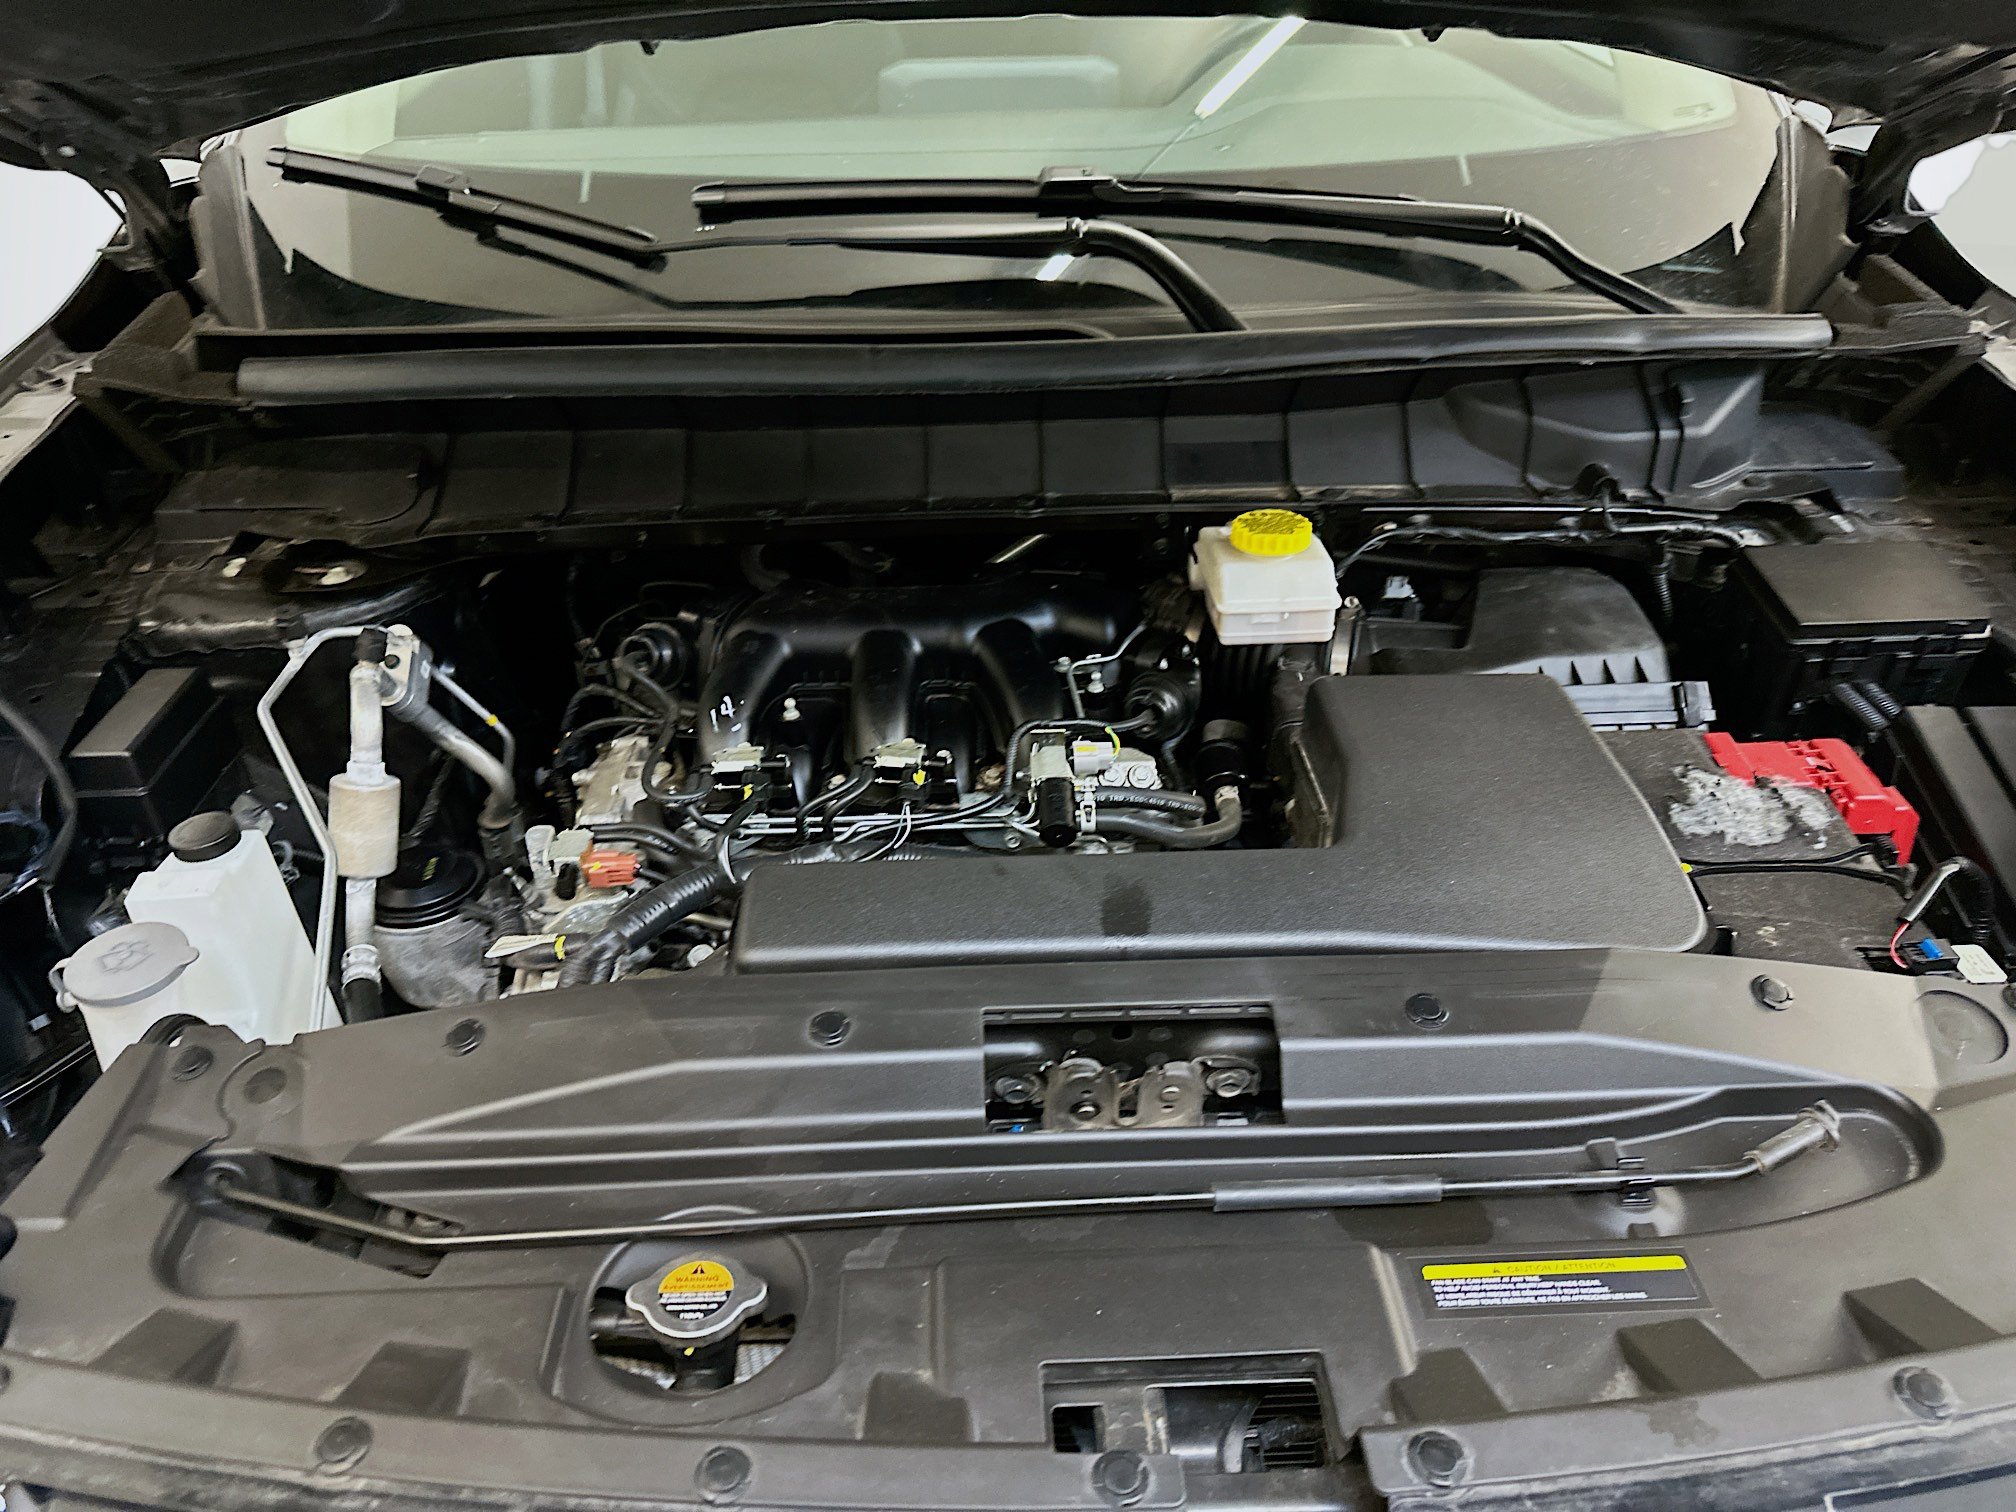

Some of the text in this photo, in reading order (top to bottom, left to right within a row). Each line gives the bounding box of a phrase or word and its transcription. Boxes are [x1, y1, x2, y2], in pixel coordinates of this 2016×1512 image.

[1506, 1264, 1551, 1273] CAUTION
[1562, 1262, 1616, 1271] ATTENTION
[676, 1275, 719, 1283] WARNING
